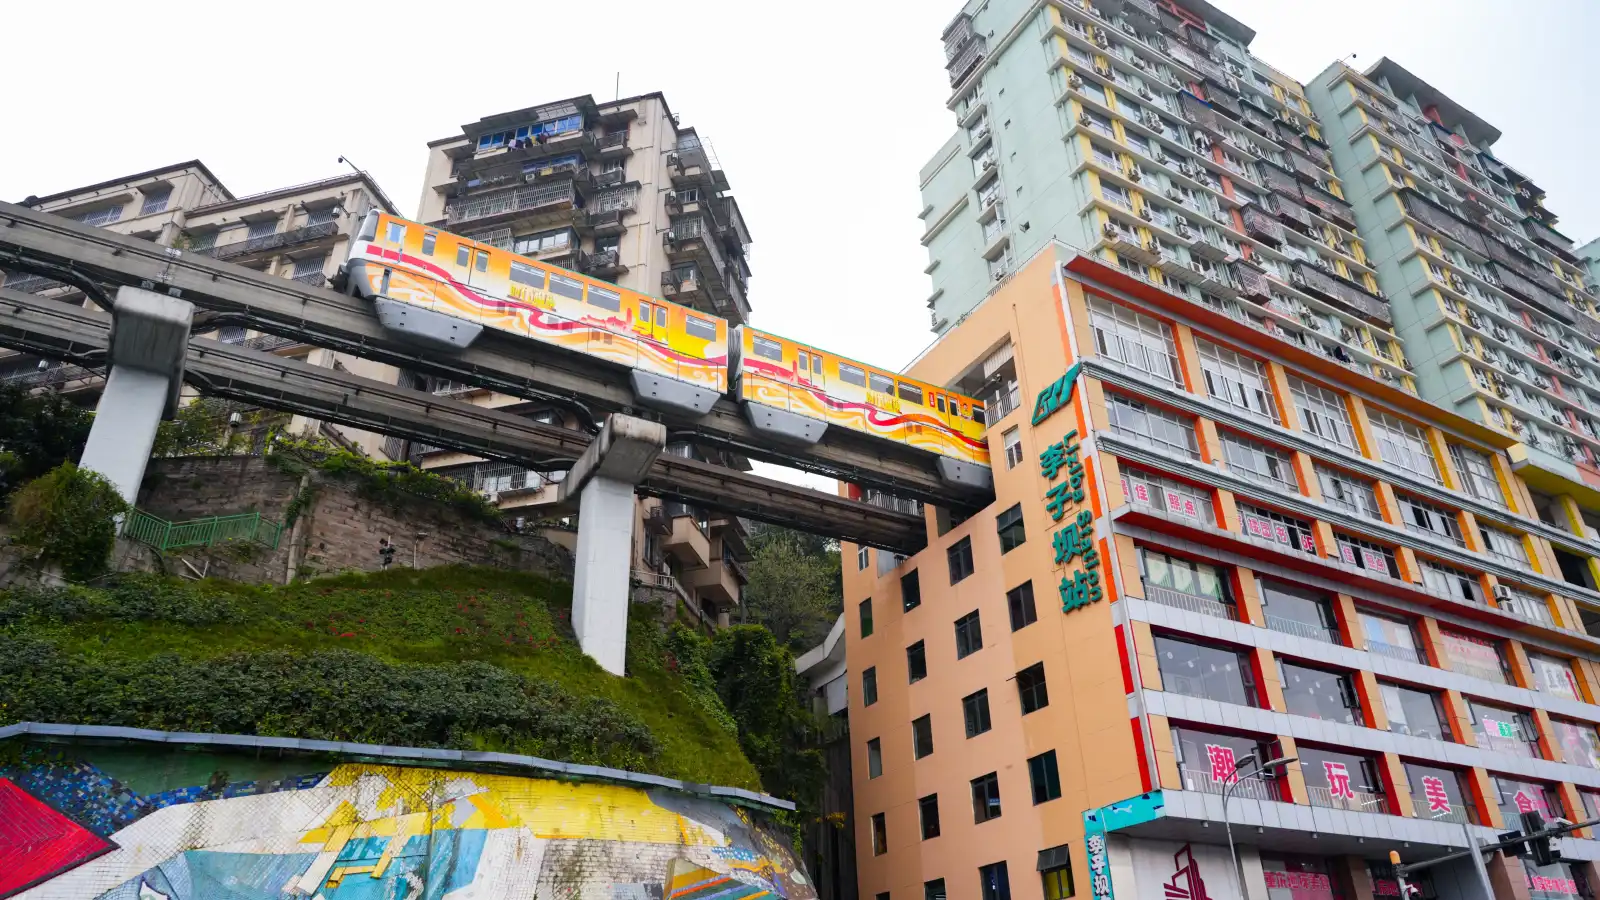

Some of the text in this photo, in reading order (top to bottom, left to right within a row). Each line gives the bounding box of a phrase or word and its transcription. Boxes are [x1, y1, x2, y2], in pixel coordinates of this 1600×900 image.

[1040, 441, 1090, 613] 李子坝站
[1063, 429, 1103, 602] Liziba Station
[1322, 760, 1354, 800] 玩
[1421, 775, 1452, 814] 美
[1087, 834, 1112, 900] 李子坝
